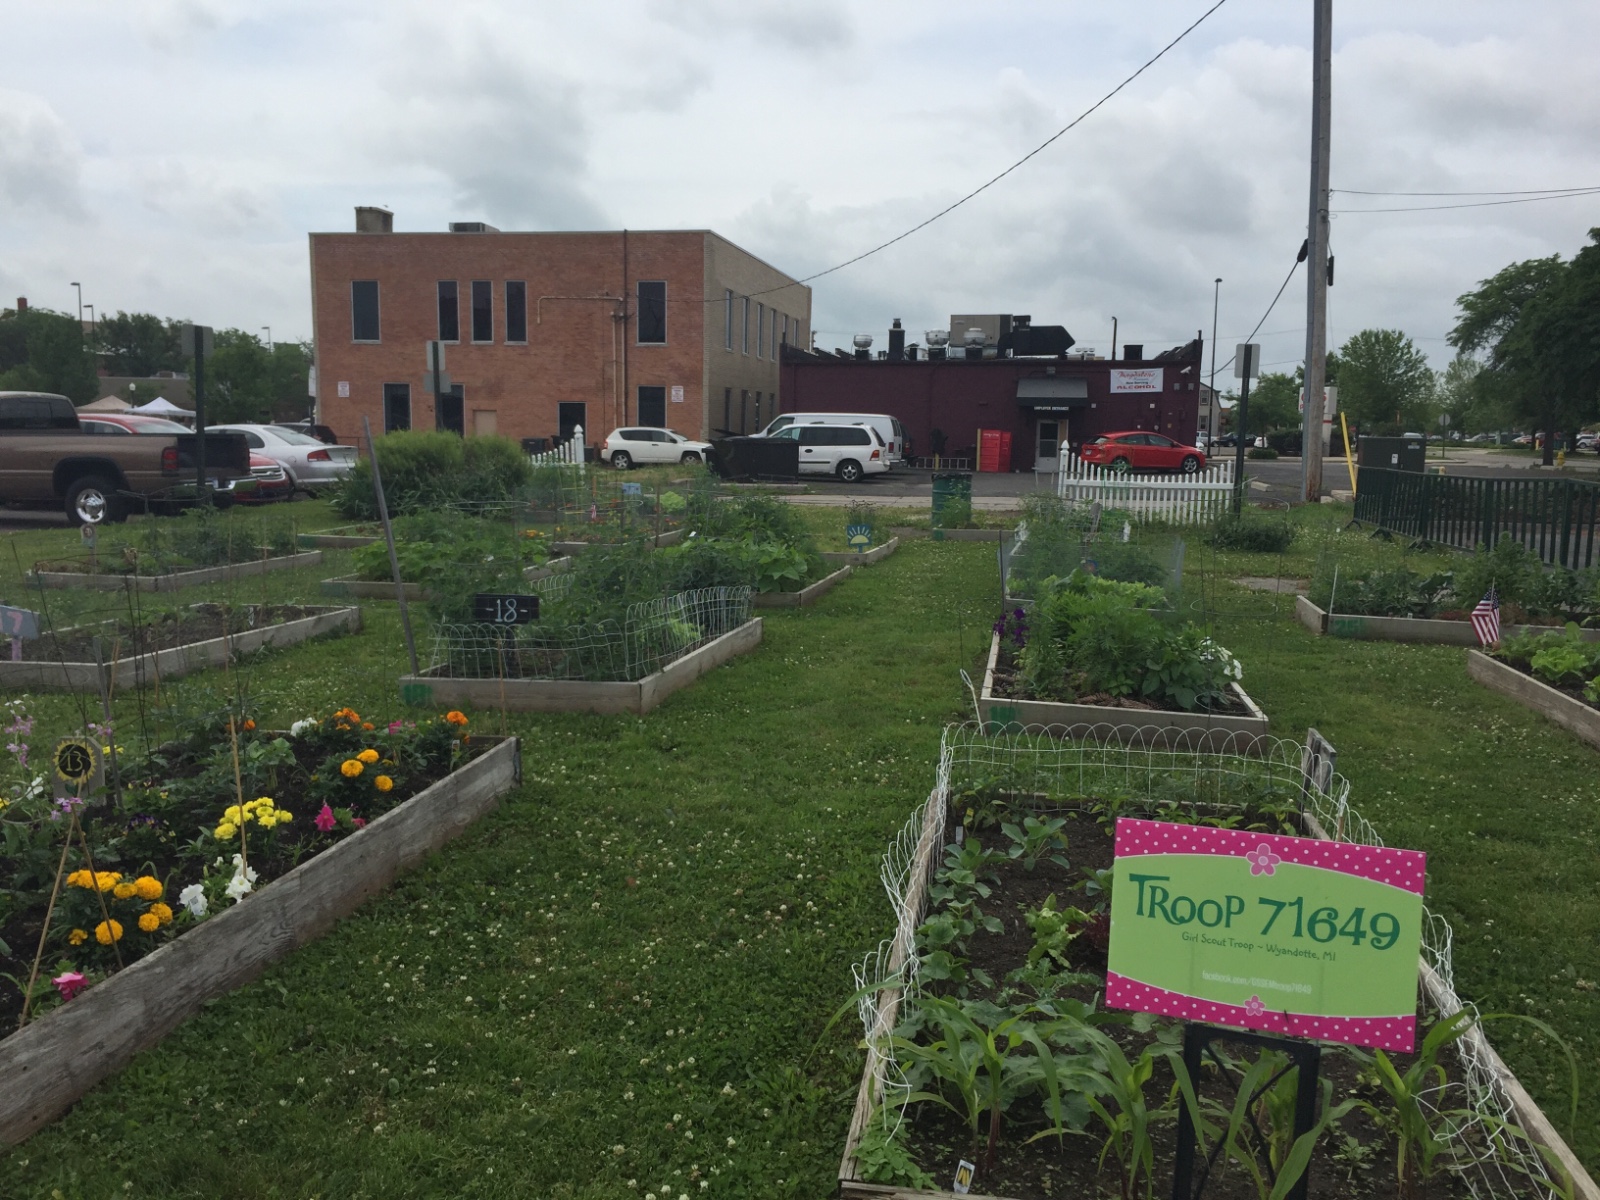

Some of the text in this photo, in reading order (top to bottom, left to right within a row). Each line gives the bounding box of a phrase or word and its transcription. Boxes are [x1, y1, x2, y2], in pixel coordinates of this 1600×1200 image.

[65, 750, 84, 772] 13
[1258, 896, 1401, 951] 71649
[1181, 931, 1199, 943] Girl
[1201, 933, 1226, 947] Scout
[1228, 937, 1255, 952] Troop
[1266, 943, 1320, 960] Wyandotte,
